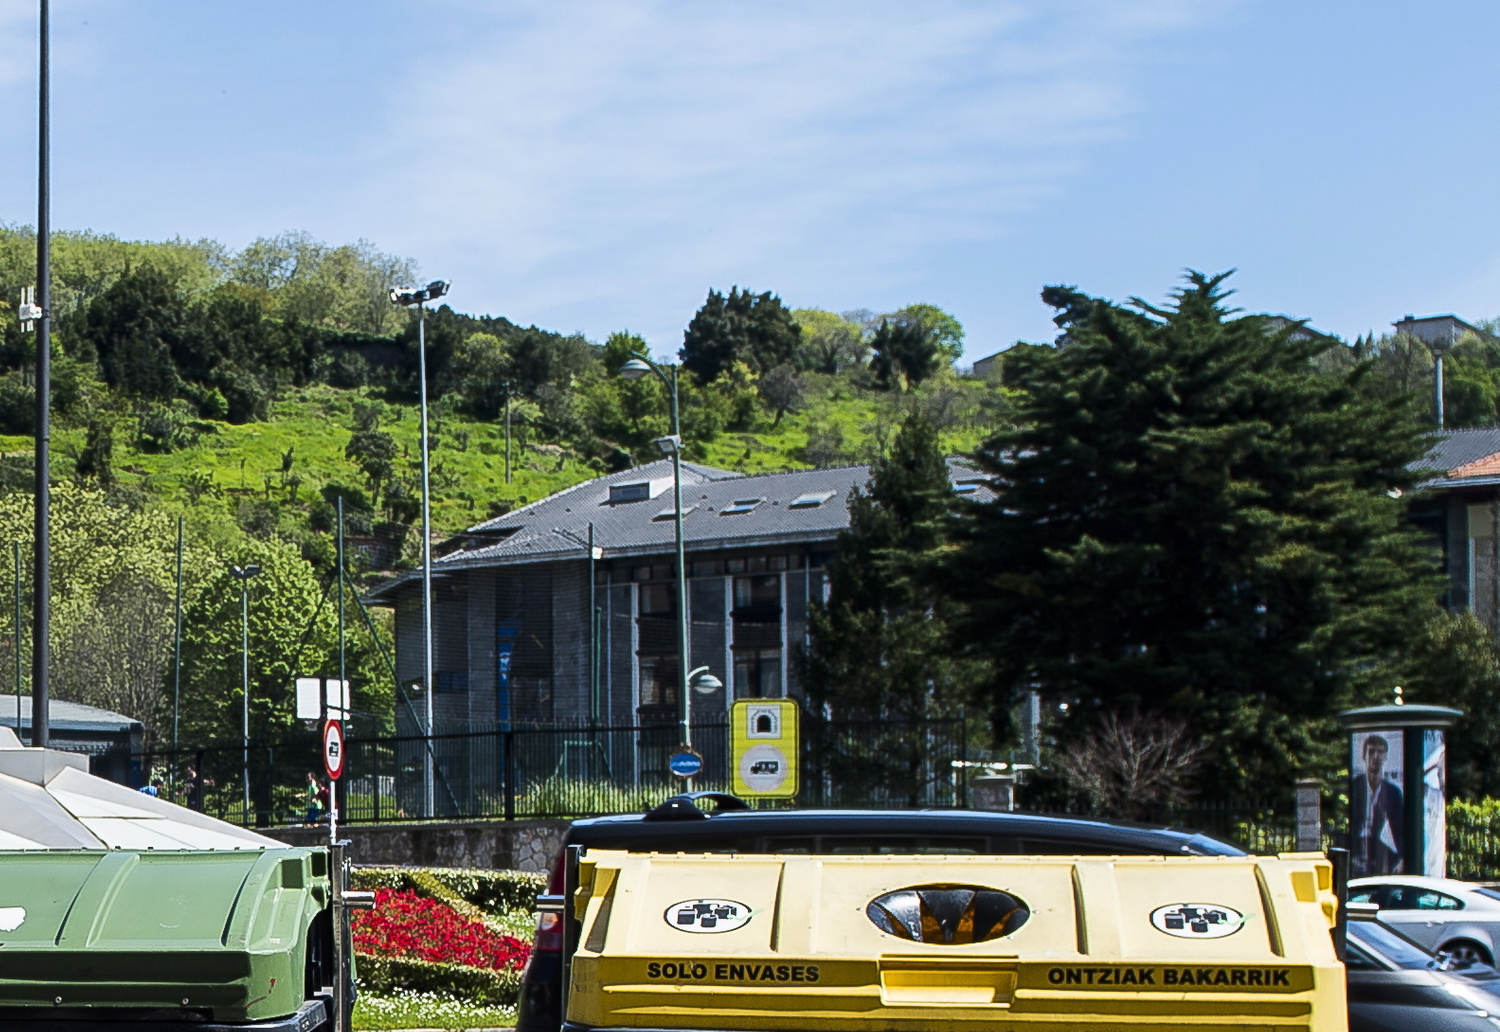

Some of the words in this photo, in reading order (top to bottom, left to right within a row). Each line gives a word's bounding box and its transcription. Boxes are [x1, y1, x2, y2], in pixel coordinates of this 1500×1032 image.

[647, 962, 708, 980] SOLO
[714, 963, 820, 983] ENVASES
[1048, 967, 1156, 986] ONTZIAK
[1163, 968, 1291, 987] BAKARRIK
